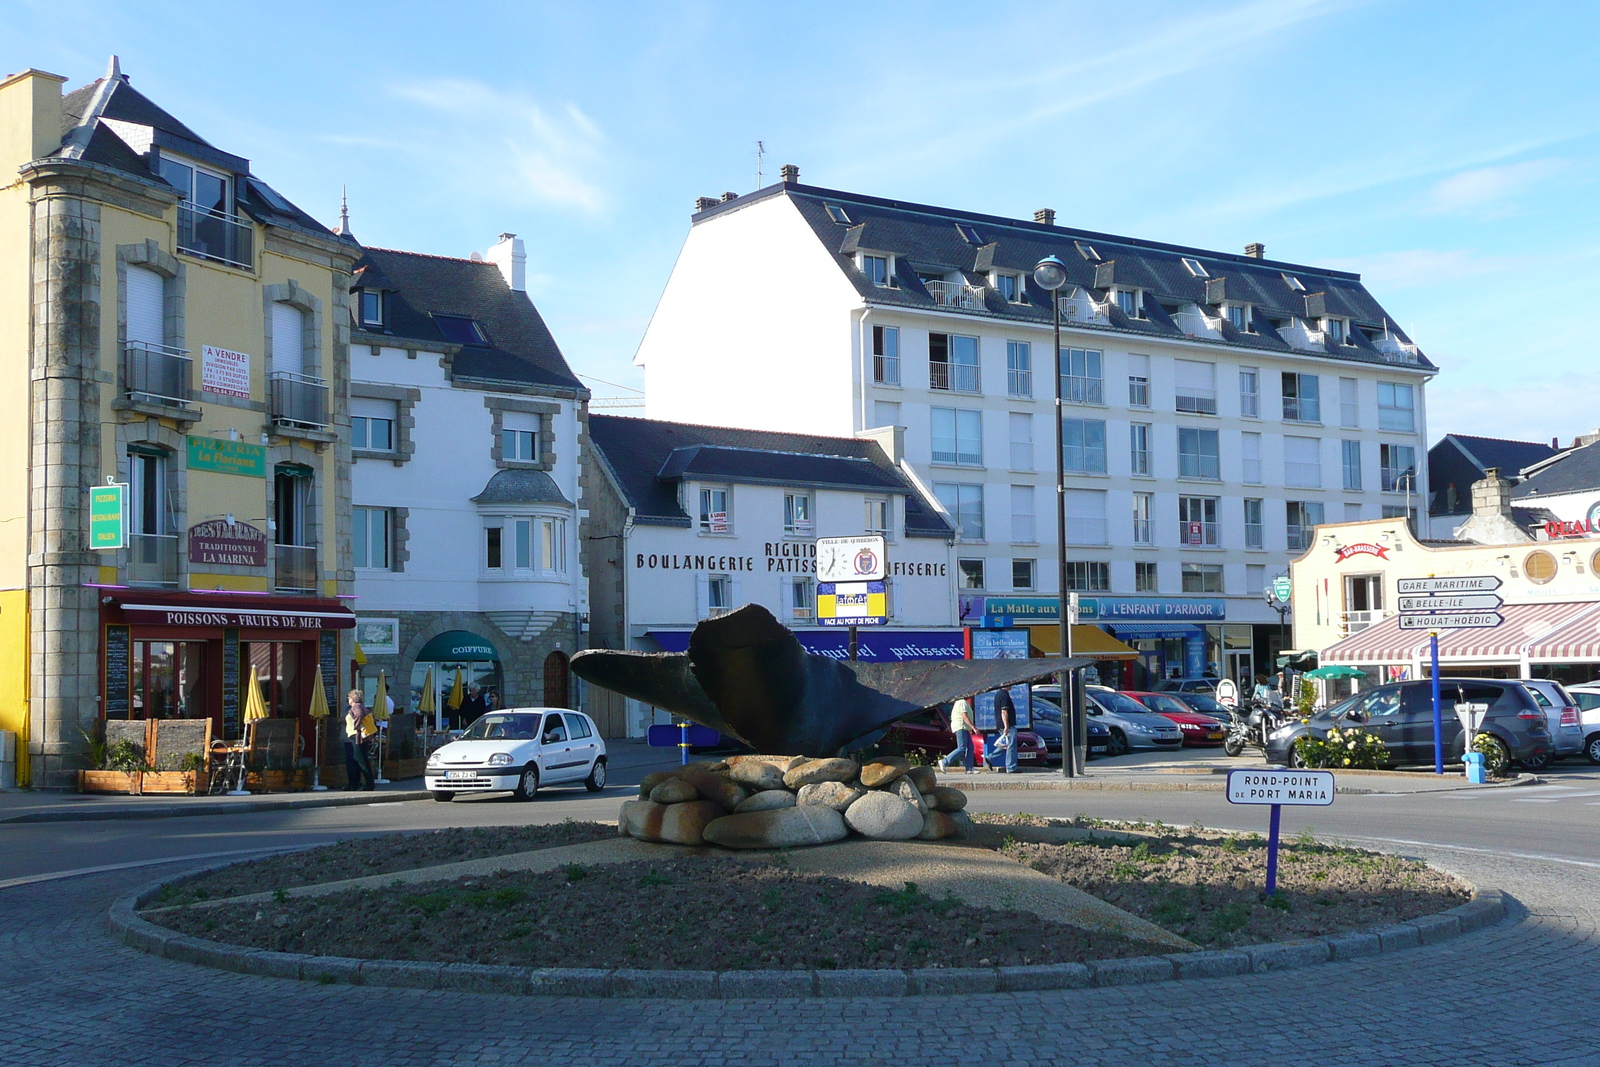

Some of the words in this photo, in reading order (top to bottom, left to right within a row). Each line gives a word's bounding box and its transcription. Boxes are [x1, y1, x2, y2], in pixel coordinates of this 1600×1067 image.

[215, 349, 246, 363] VENDRE
[205, 361, 226, 370] DIVISION
[192, 438, 261, 456] PIZZERIA
[199, 451, 211, 462] La
[213, 453, 256, 467] Floriana
[96, 494, 117, 503] PIZZERIA
[1544, 518, 1592, 538] QUAI
[97, 532, 116, 540] ITALIEN
[199, 542, 258, 553] TRADITIONNEL
[1343, 544, 1379, 557] BAR-BRASSERIE
[203, 553, 216, 562] LA
[218, 553, 255, 565] MARINA
[636, 553, 753, 572] BOULANGERIE
[1402, 582, 1428, 590] GARE
[1434, 580, 1484, 590] MARITIME
[1526, 588, 1558, 596] MOULES
[990, 603, 1004, 614] La
[1006, 603, 1035, 614] Malle
[1037, 604, 1057, 614] aux
[1416, 598, 1464, 608] BELLE-ÎLE
[1112, 603, 1161, 616] L'ENFANT
[1165, 603, 1213, 616] D'ARMOR
[166, 612, 229, 625] POISSONS
[238, 614, 280, 627] FRUITS
[282, 616, 297, 627] DE
[299, 617, 323, 629] MER
[824, 618, 836, 626] FACE
[857, 617, 864, 625] DE
[864, 617, 880, 625] PECHE
[451, 646, 494, 655] COIFFURE
[1244, 776, 1319, 787] ROND-POINT
[1250, 789, 1281, 799] PORT
[1288, 789, 1327, 800] MARIA
